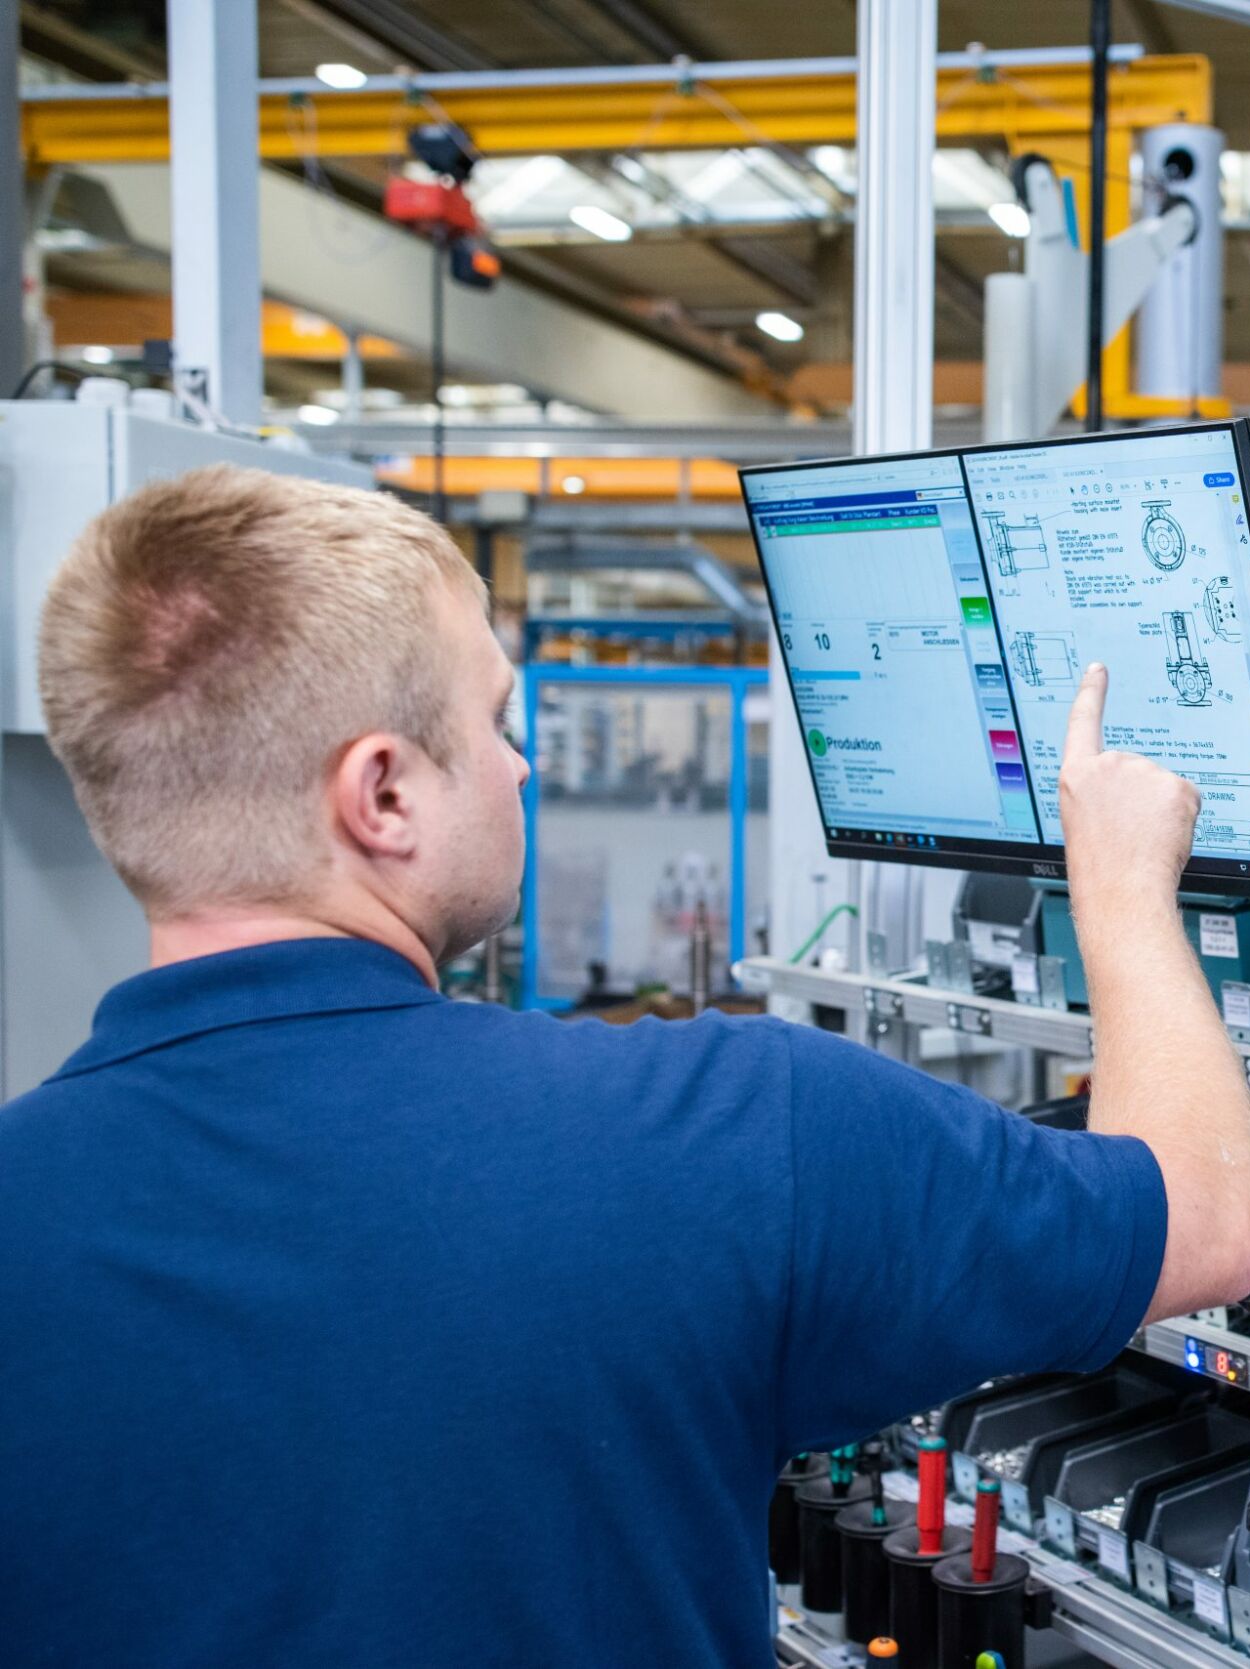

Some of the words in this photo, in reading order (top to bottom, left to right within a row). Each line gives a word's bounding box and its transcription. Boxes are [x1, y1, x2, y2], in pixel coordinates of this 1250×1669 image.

[815, 633, 830, 650] 10
[872, 644, 882, 660] 2
[826, 736, 882, 751] Produktion
[1208, 793, 1236, 801] DRAWING
[1033, 864, 1058, 876] DELL
